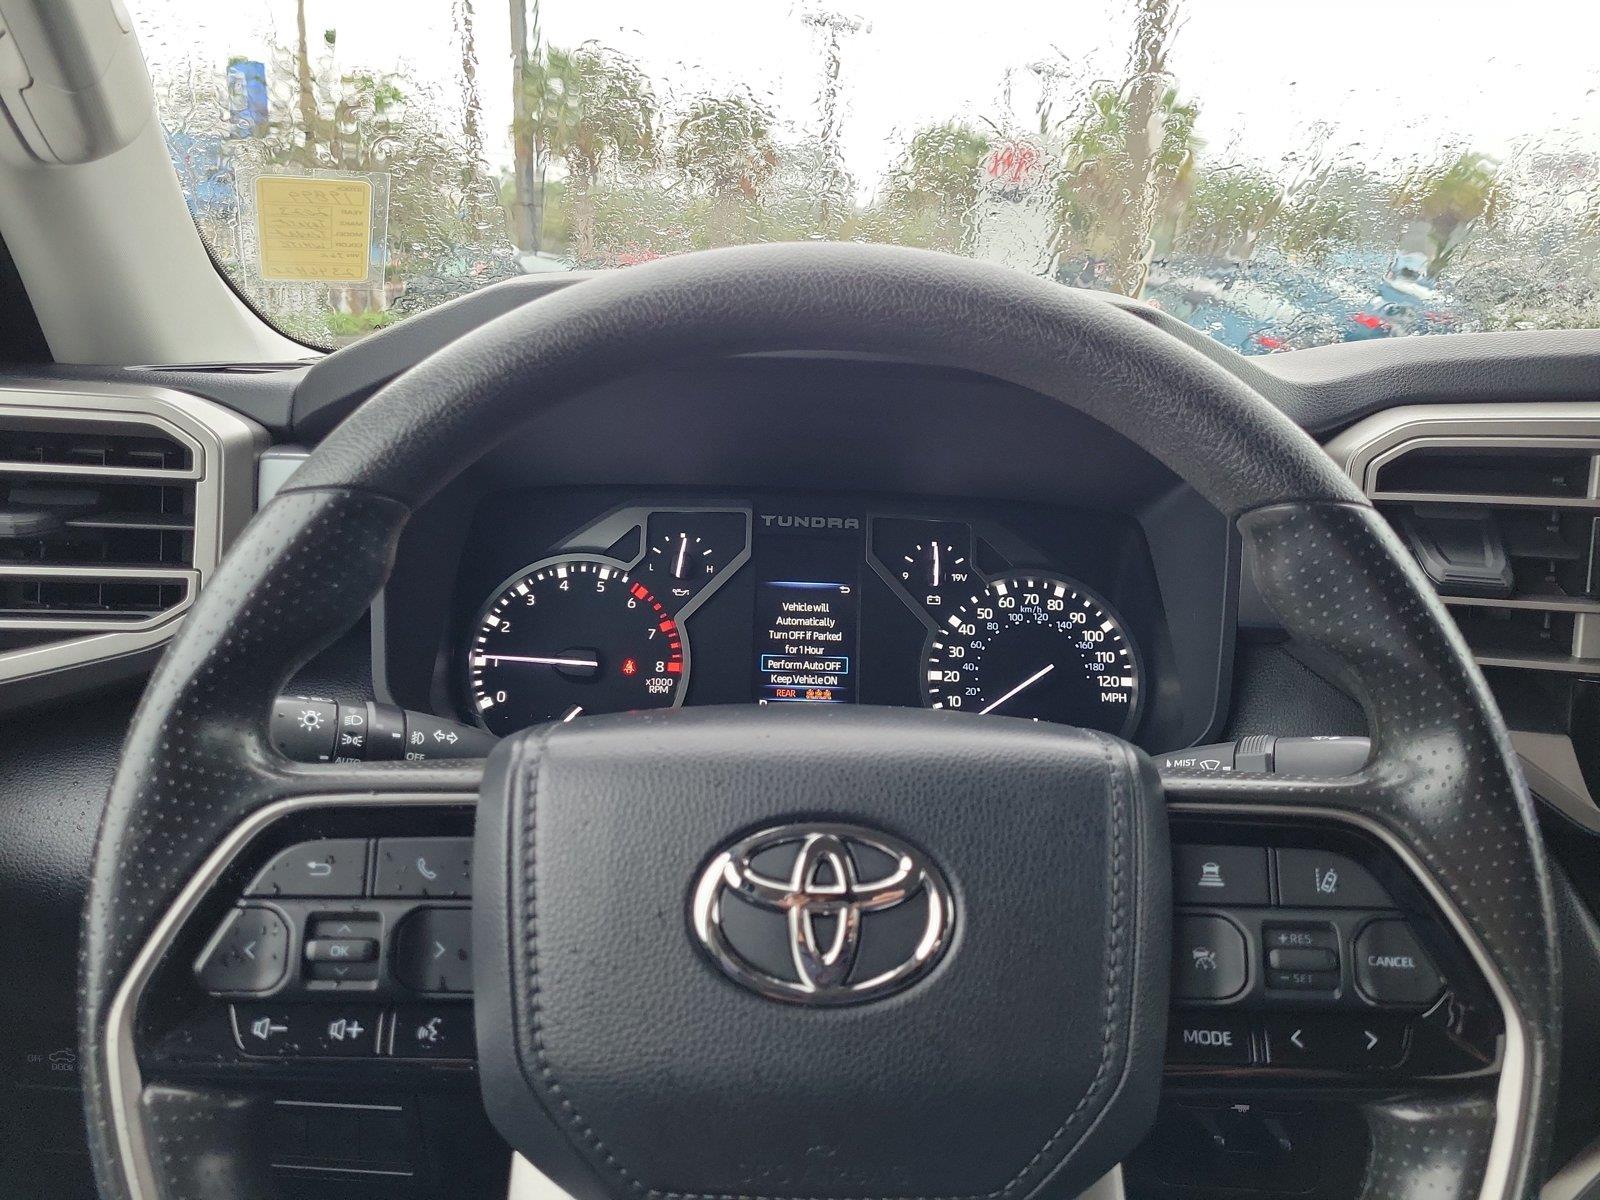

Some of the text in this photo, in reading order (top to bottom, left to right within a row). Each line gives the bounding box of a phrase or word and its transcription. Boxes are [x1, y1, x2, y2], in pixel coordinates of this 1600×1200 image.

[761, 514, 859, 529] TUNDRA
[706, 565, 713, 573] H
[902, 572, 909, 580] 9
[952, 573, 968, 582] 19V
[559, 581, 569, 591] 4
[596, 581, 605, 592] 5
[526, 595, 535, 606] 3
[627, 598, 636, 608] 6
[998, 597, 1015, 608] 60
[1023, 594, 1039, 605] 70
[1047, 599, 1063, 611] 80
[782, 602, 830, 613] Vehicle will
[1020, 605, 1042, 614] km/h
[976, 608, 993, 619] 50
[1008, 613, 1023, 622] 100
[1033, 613, 1048, 622] 120
[1069, 612, 1086, 623] 90
[501, 622, 510, 632] 2
[776, 616, 835, 628] Automatically
[986, 622, 998, 630] 80
[1056, 621, 1072, 630] 140
[648, 629, 656, 639] 7
[958, 624, 975, 635] 40
[769, 630, 842, 641] Turn OFF if Parked
[1082, 630, 1104, 642] 100
[785, 645, 798, 654] for
[804, 646, 825, 655] Hour
[970, 640, 982, 649] 60
[1078, 641, 1094, 650] 160
[949, 646, 964, 657] 30
[1095, 651, 1115, 663] 110
[655, 661, 664, 672] 8
[768, 660, 841, 671] Perform Auto OFF
[962, 663, 974, 671] 40
[1088, 663, 1104, 671] 180
[645, 677, 673, 687] x1000
[771, 674, 838, 686] Keep Vehicle ON
[943, 671, 960, 682] 20
[1097, 676, 1119, 687] 120
[649, 685, 669, 694] RPM
[776, 689, 796, 698] REAR
[965, 687, 976, 696] 20
[496, 691, 506, 702] 0
[947, 696, 961, 707] 10
[1101, 693, 1127, 703] MPH
[406, 752, 425, 761] OFF
[1173, 758, 1196, 768] MIST
[330, 945, 349, 957] OK
[1368, 955, 1415, 968] CANCEL
[1183, 1029, 1233, 1046] MODE
